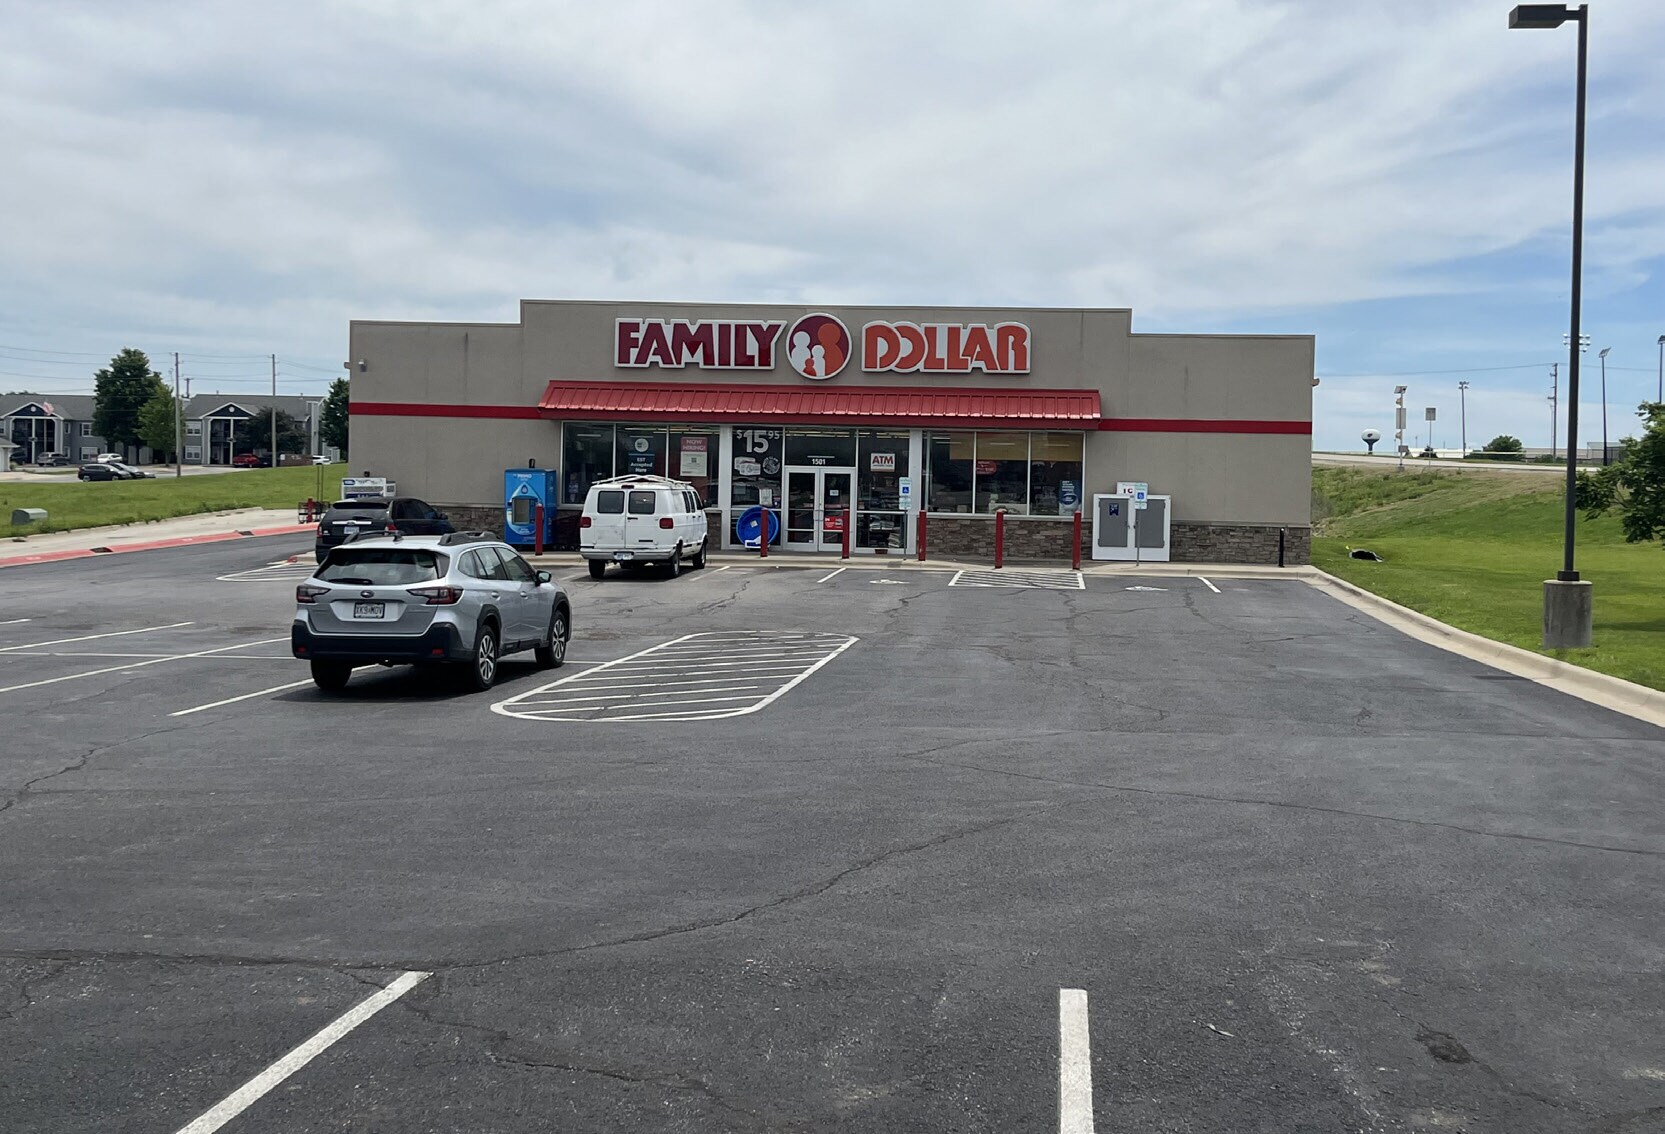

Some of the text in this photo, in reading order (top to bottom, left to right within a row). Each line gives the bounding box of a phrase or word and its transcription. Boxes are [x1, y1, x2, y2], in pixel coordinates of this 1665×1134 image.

[616, 319, 1030, 373] FAMILY DOLLAR
[872, 455, 894, 464] ATM
